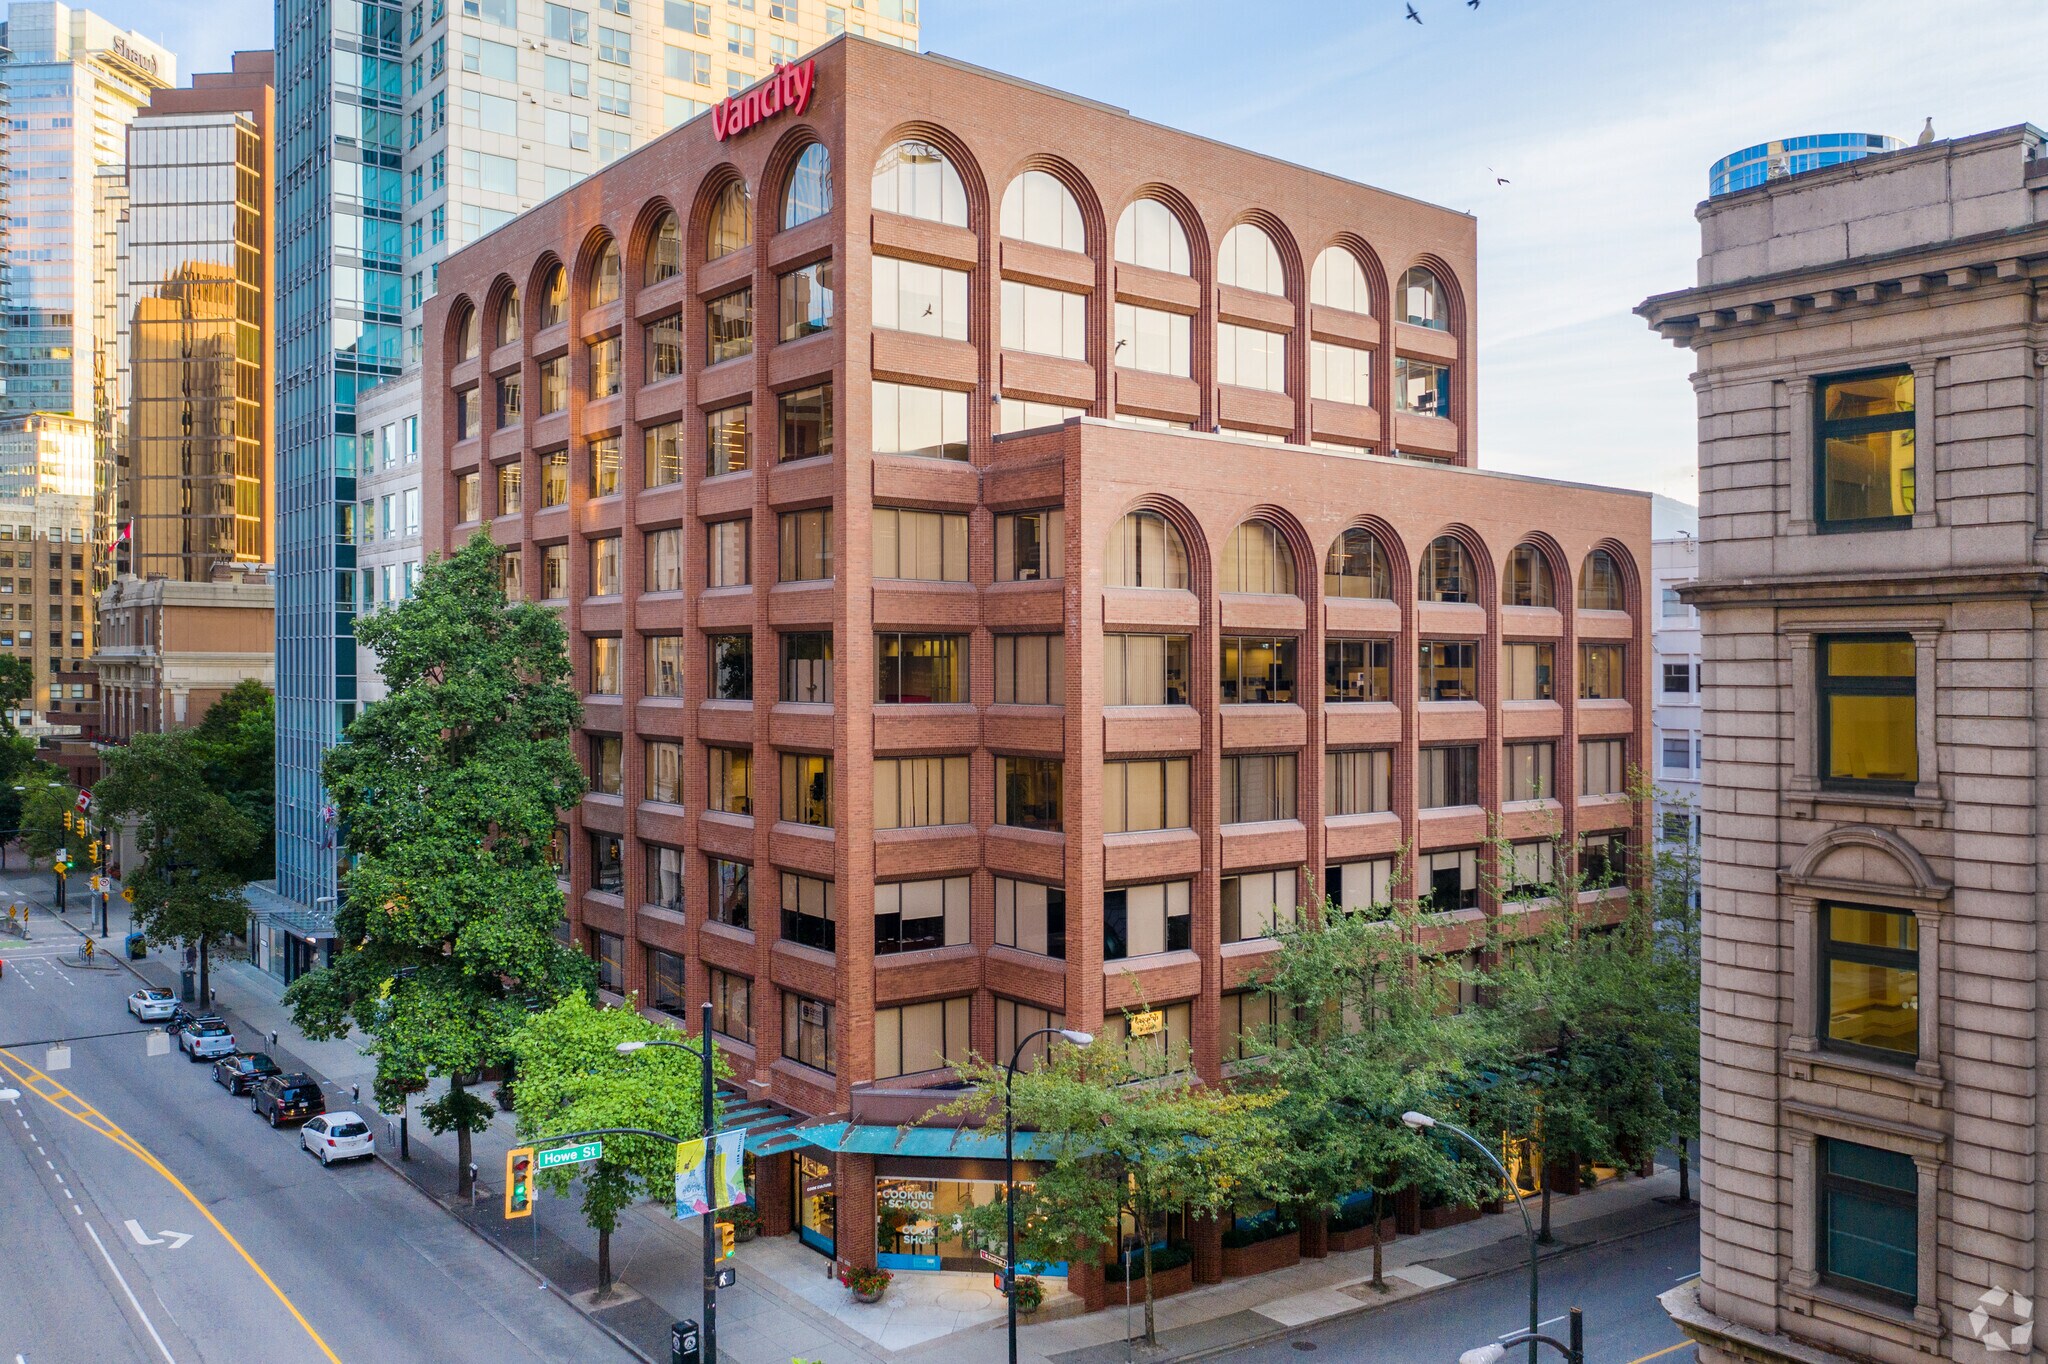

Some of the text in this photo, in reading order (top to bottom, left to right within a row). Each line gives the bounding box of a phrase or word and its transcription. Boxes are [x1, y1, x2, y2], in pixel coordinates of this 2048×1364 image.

[711, 59, 815, 142] Vancity
[544, 1146, 596, 1165] Howe St
[882, 1189, 934, 1200] COOKING
[888, 1199, 934, 1210] SCHOOL
[902, 1225, 935, 1236] COOK
